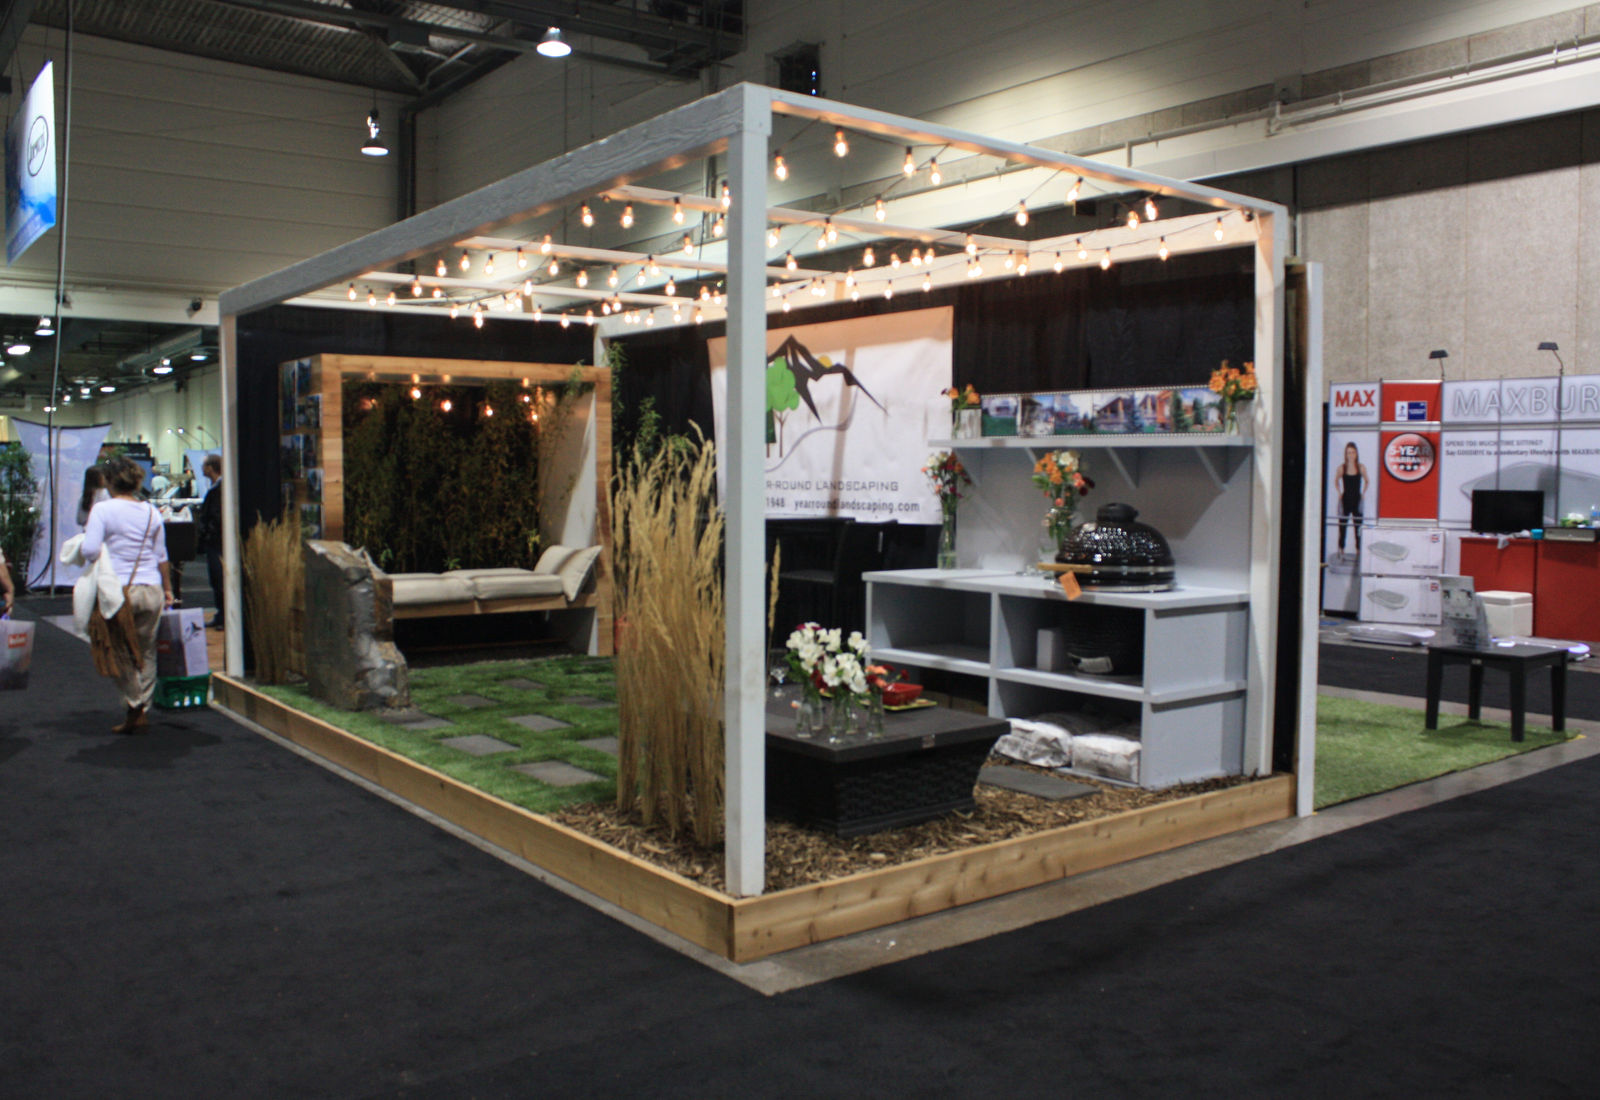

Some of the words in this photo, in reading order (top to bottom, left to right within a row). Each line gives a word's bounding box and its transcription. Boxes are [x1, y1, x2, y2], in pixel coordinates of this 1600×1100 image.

[1335, 389, 1376, 408] MAX
[1453, 384, 1600, 416] MAXBUR
[765, 480, 812, 490] R-ROUND
[815, 480, 899, 492] LANDSCAPING
[794, 498, 920, 514] yearroundlandscaping.com
